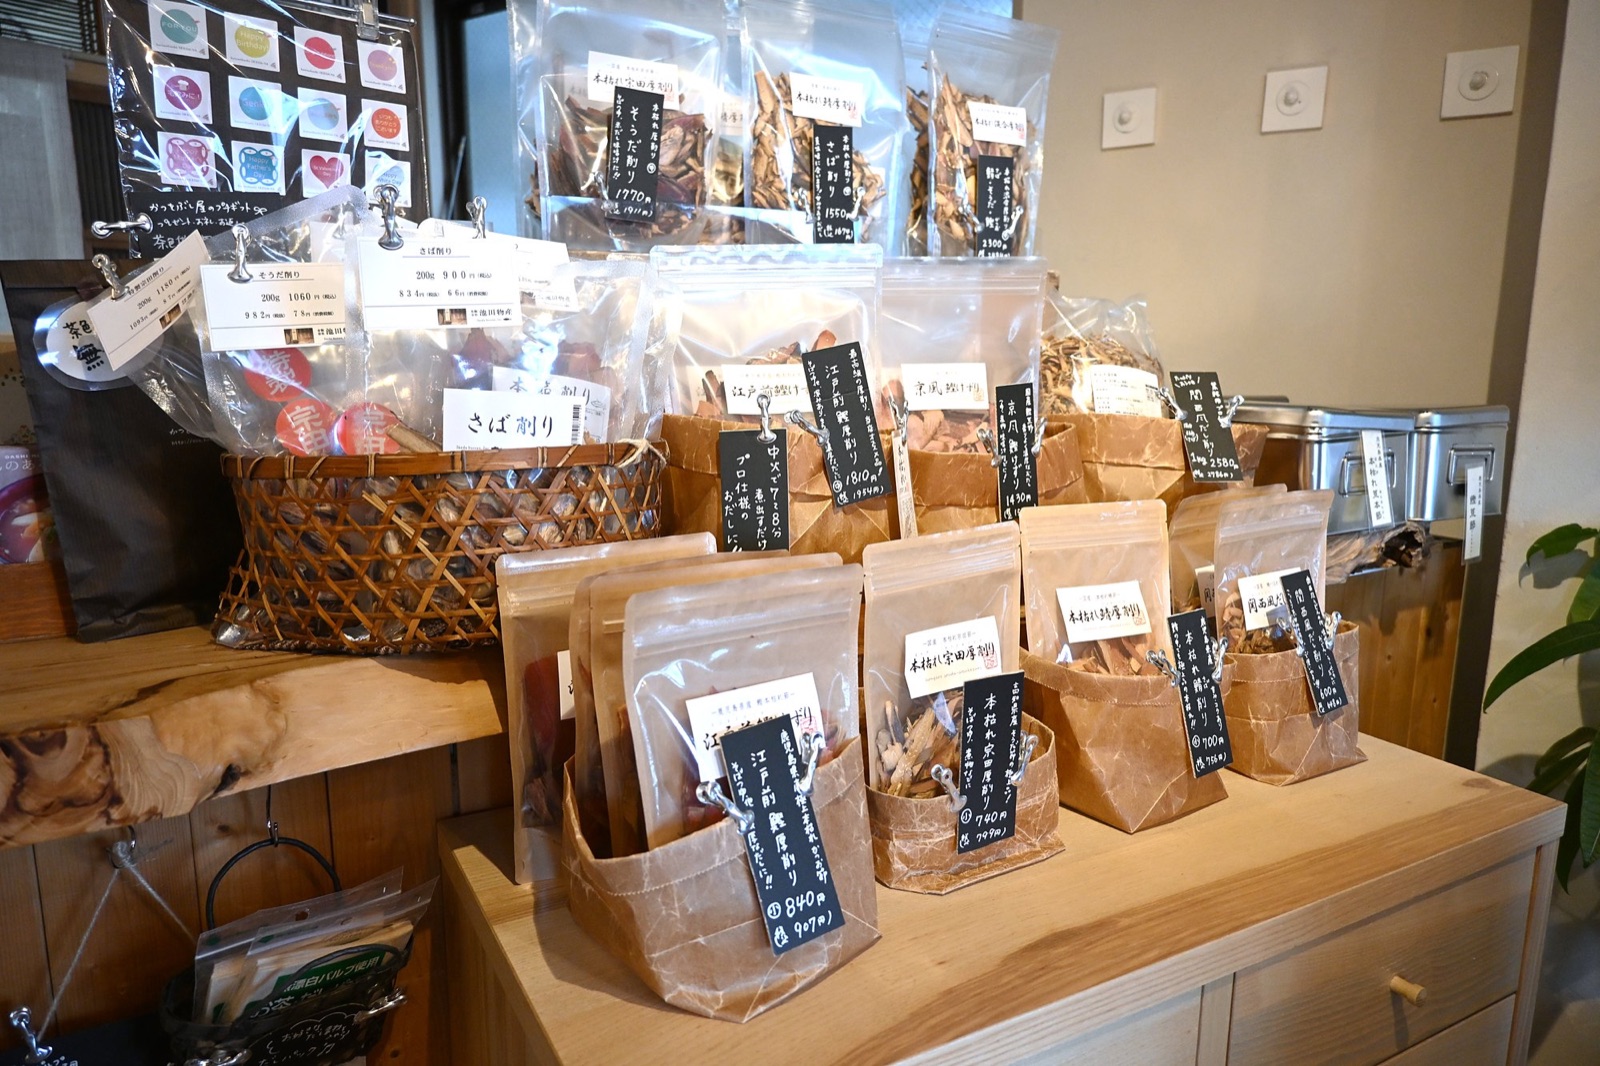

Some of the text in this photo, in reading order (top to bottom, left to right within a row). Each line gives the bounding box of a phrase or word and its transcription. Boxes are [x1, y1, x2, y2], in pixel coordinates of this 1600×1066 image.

[240, 31, 264, 42] Happy
[626, 106, 642, 184] そうだ削り
[826, 141, 840, 198] さば削り
[615, 188, 652, 204] 1770円
[419, 247, 453, 256] さば削り
[258, 271, 300, 280] そうだ削り
[416, 271, 436, 281] 200g
[261, 293, 281, 303] 200g
[468, 412, 554, 438] さば削り
[825, 364, 859, 466] 江戸前鰹厚削り
[1189, 389, 1214, 457] 関西風だし削り
[1007, 399, 1022, 490] 京風鰹けずり
[1190, 452, 1239, 470] 1kg 2580円
[734, 452, 752, 521] プロ仕様の
[845, 469, 878, 486] 1810円
[1006, 492, 1032, 507] 1430円
[754, 488, 767, 551] 煮出すだけ
[1068, 603, 1141, 625] 本枯れ鯖厚削り
[909, 642, 995, 674] 本枯れ宗田厚削り
[1185, 629, 1208, 727] 本枯れ鯖削り
[982, 693, 998, 811] 本枯れ宗田厚削り
[1202, 734, 1225, 750] 700円
[750, 749, 798, 888] 江戸前鰹厚削り
[975, 810, 1007, 827] 740円
[785, 890, 827, 918] 840円
